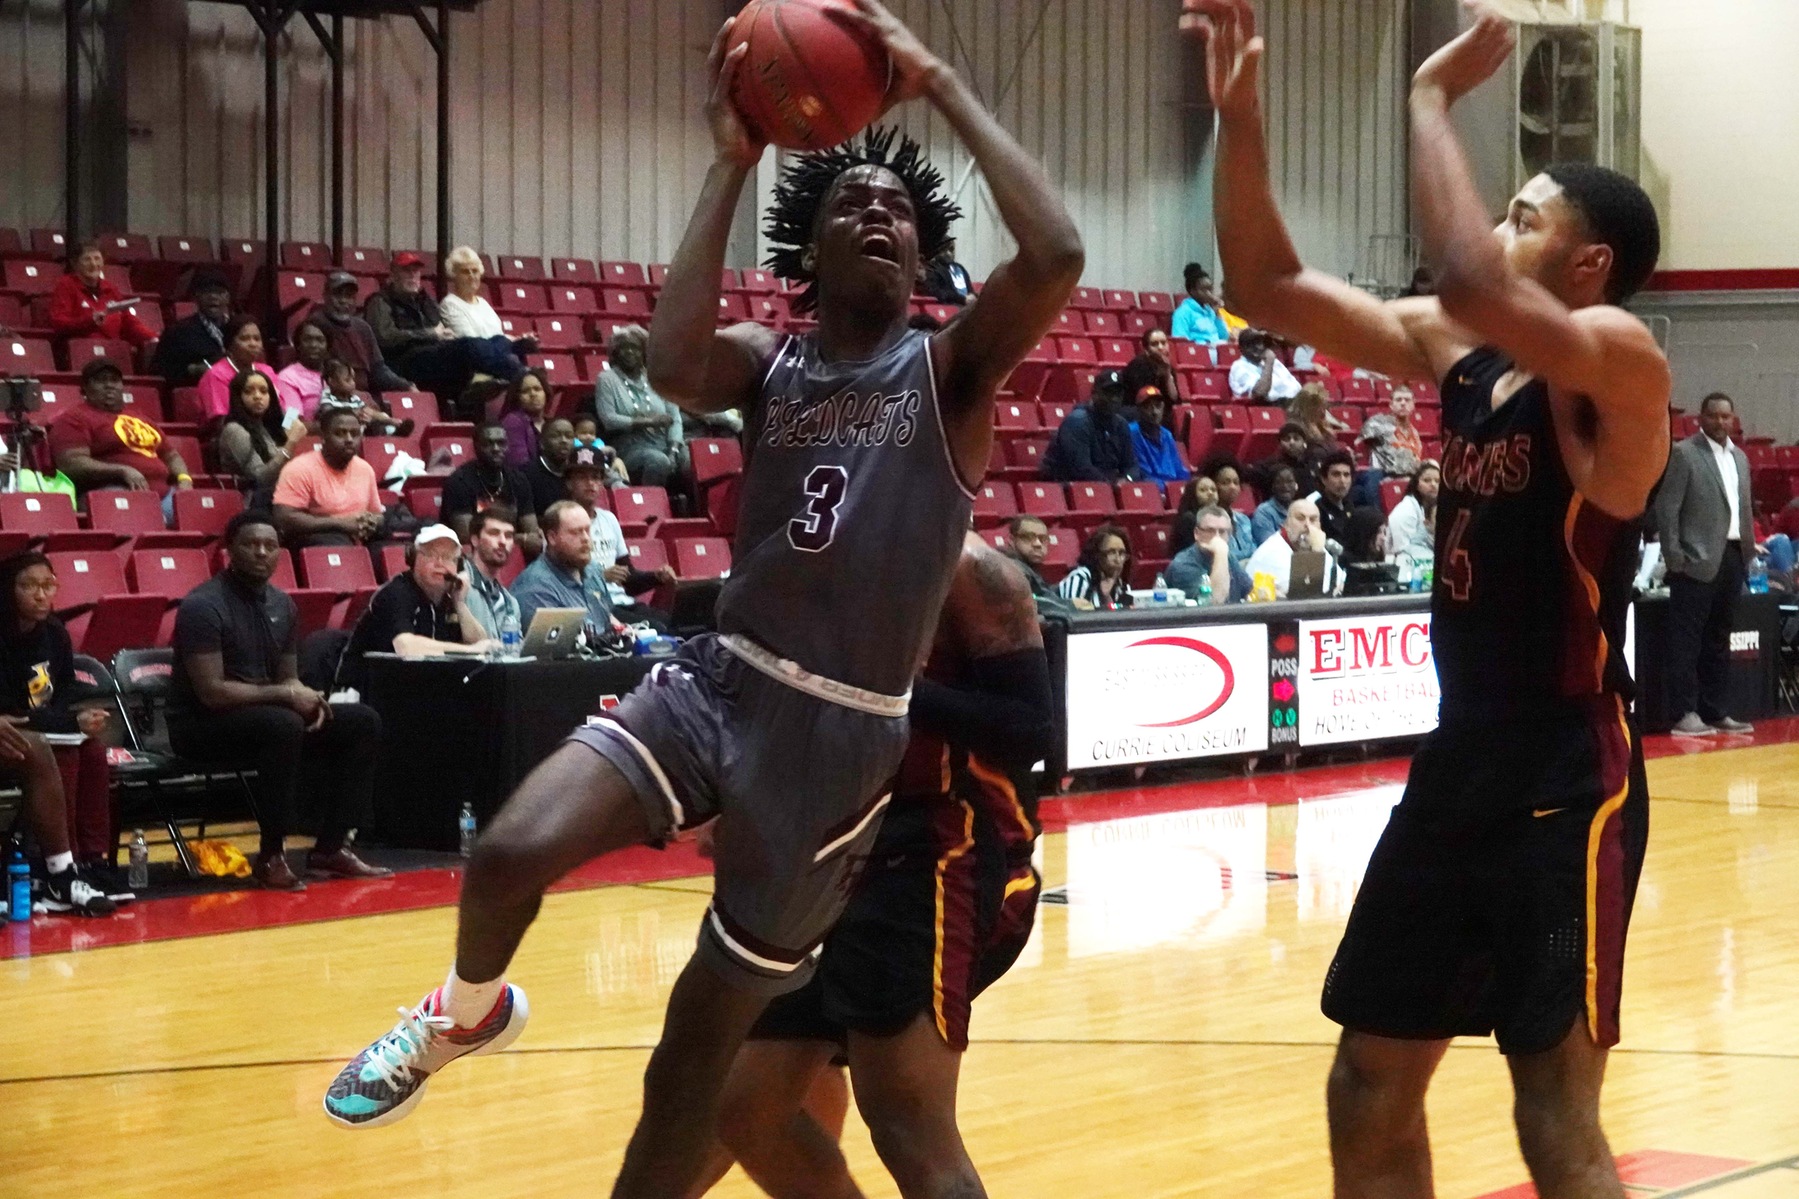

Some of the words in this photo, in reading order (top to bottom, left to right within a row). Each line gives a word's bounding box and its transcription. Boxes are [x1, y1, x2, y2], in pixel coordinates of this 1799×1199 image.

[1441, 429, 1531, 496] ONES
[786, 465, 849, 553] 3
[1441, 507, 1472, 601] 4
[1309, 622, 1431, 678] EMC
[1729, 629, 1760, 652] SSIPPI
[1271, 657, 1298, 677] POSS
[1333, 682, 1440, 706] BASKETBAL
[1092, 735, 1157, 761] CURRIE
[1162, 727, 1247, 754] COLISEUM
[1271, 725, 1297, 744] BONUS
